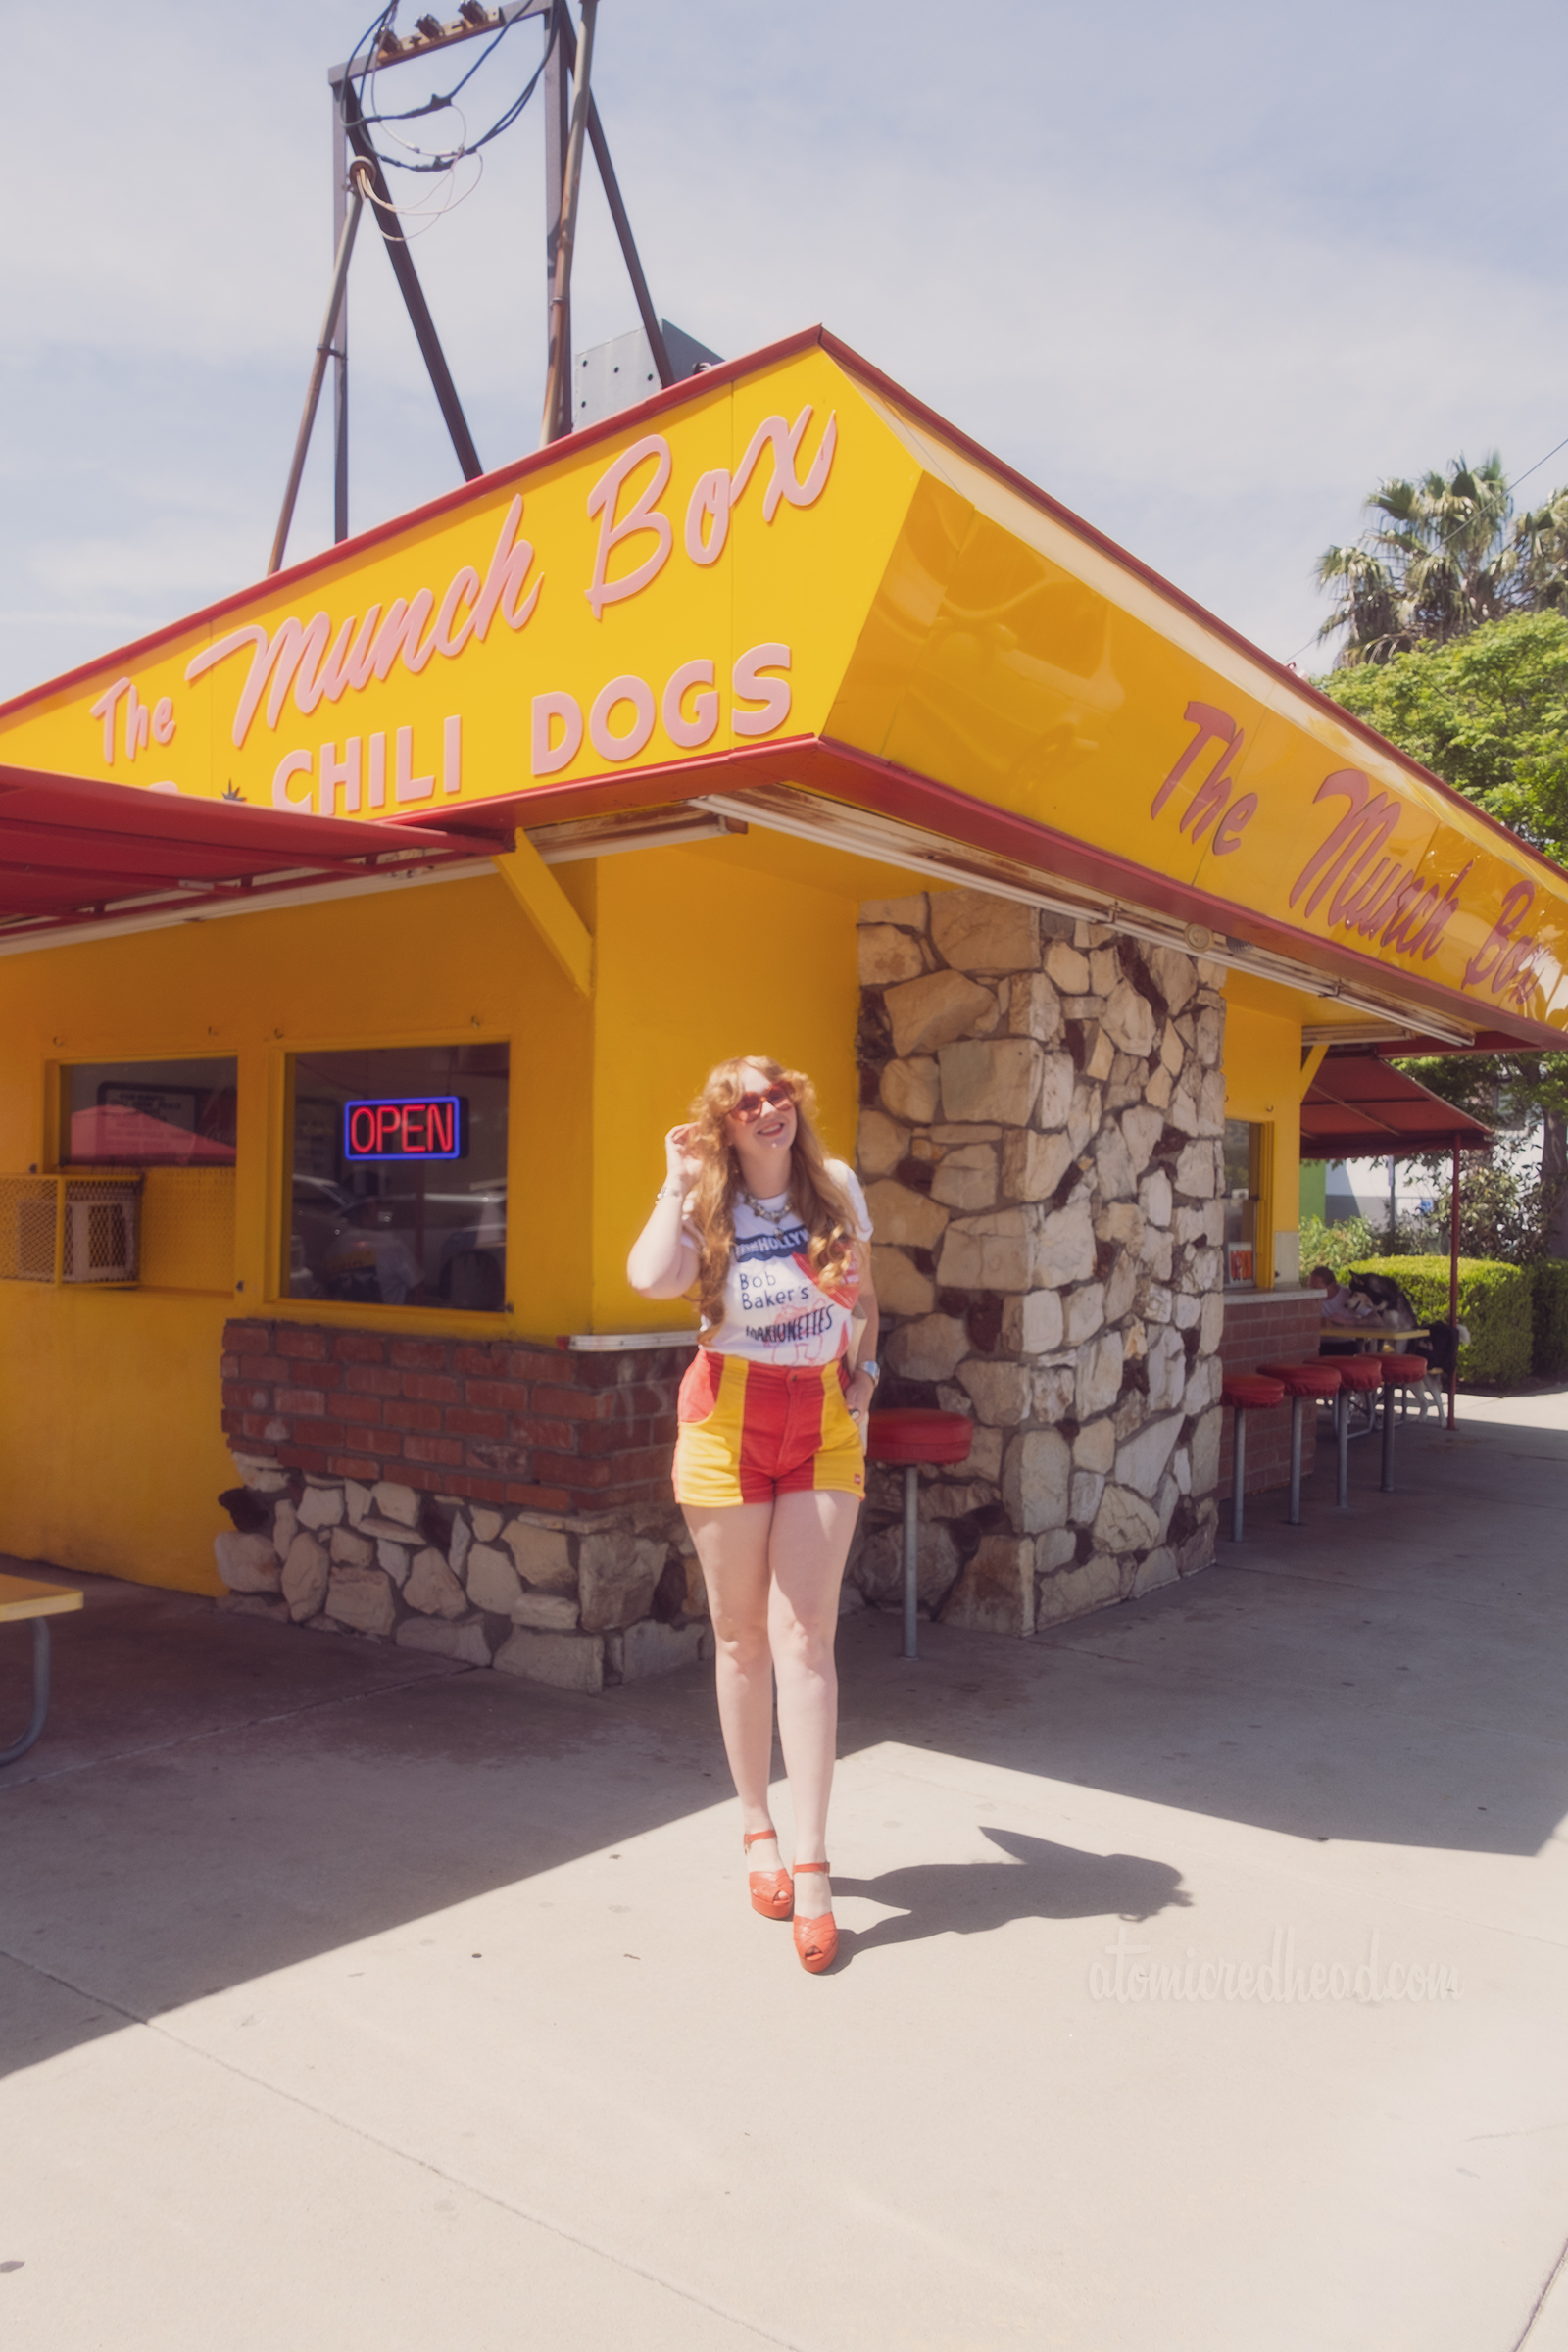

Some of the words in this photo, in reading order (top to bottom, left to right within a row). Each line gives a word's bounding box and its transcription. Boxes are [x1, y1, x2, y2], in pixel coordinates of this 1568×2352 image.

[90, 676, 177, 764] The
[184, 493, 545, 748] Munch
[584, 404, 839, 620] Box
[271, 714, 461, 817] CHILI
[530, 642, 792, 777] DOGS
[1151, 701, 1258, 856] The
[1289, 768, 1474, 961] Munch
[350, 1103, 453, 1153] OPEN
[739, 1271, 776, 1290] Bob
[742, 1285, 809, 1310] Baker's
